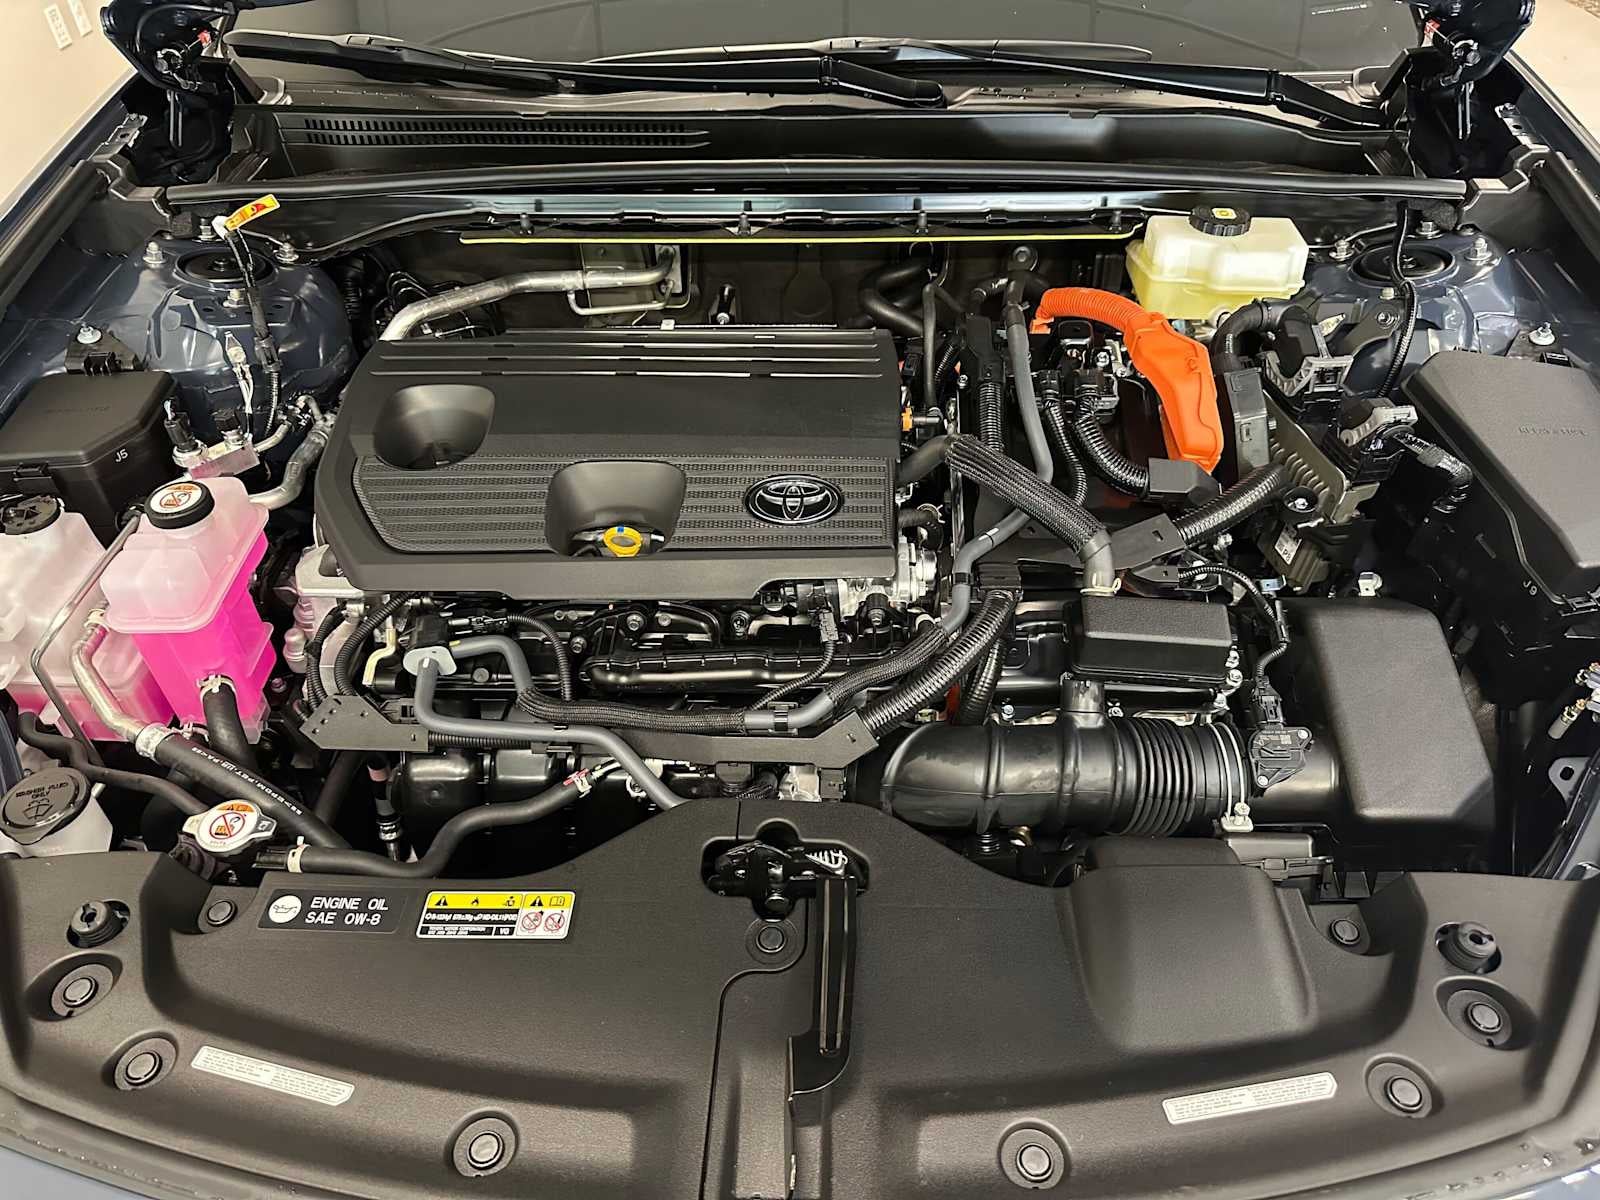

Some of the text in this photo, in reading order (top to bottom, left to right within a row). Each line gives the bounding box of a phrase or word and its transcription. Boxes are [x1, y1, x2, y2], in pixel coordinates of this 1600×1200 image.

[116, 448, 128, 462] J5
[310, 896, 389, 911] ENGINE OIL
[304, 911, 337, 925] SAE
